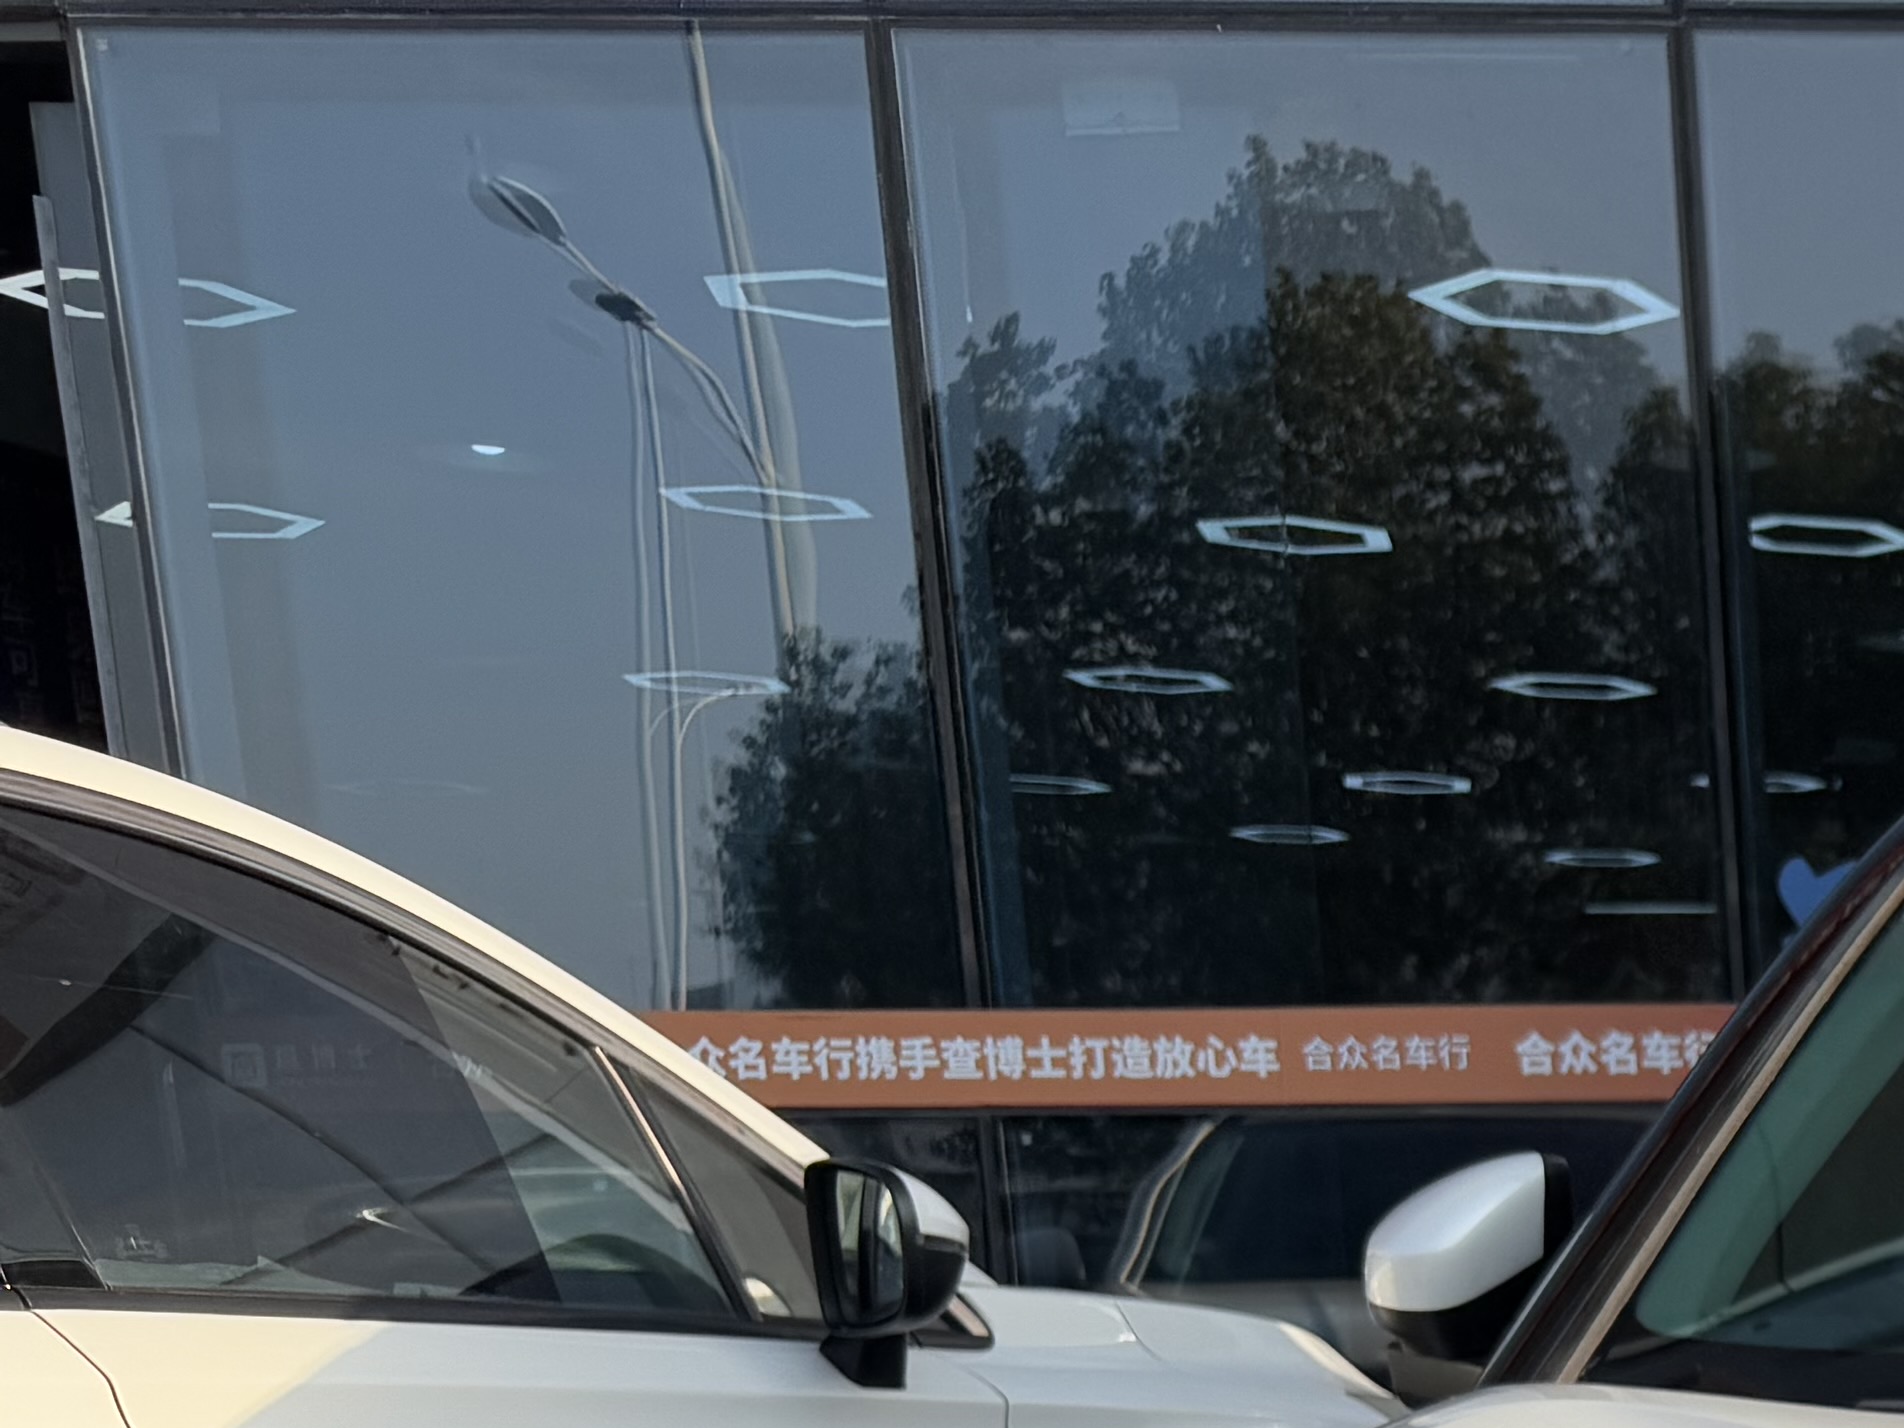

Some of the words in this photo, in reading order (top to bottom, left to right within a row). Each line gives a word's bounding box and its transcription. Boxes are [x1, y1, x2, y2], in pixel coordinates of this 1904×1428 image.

[1304, 1034, 1471, 1071] 合众名车行
